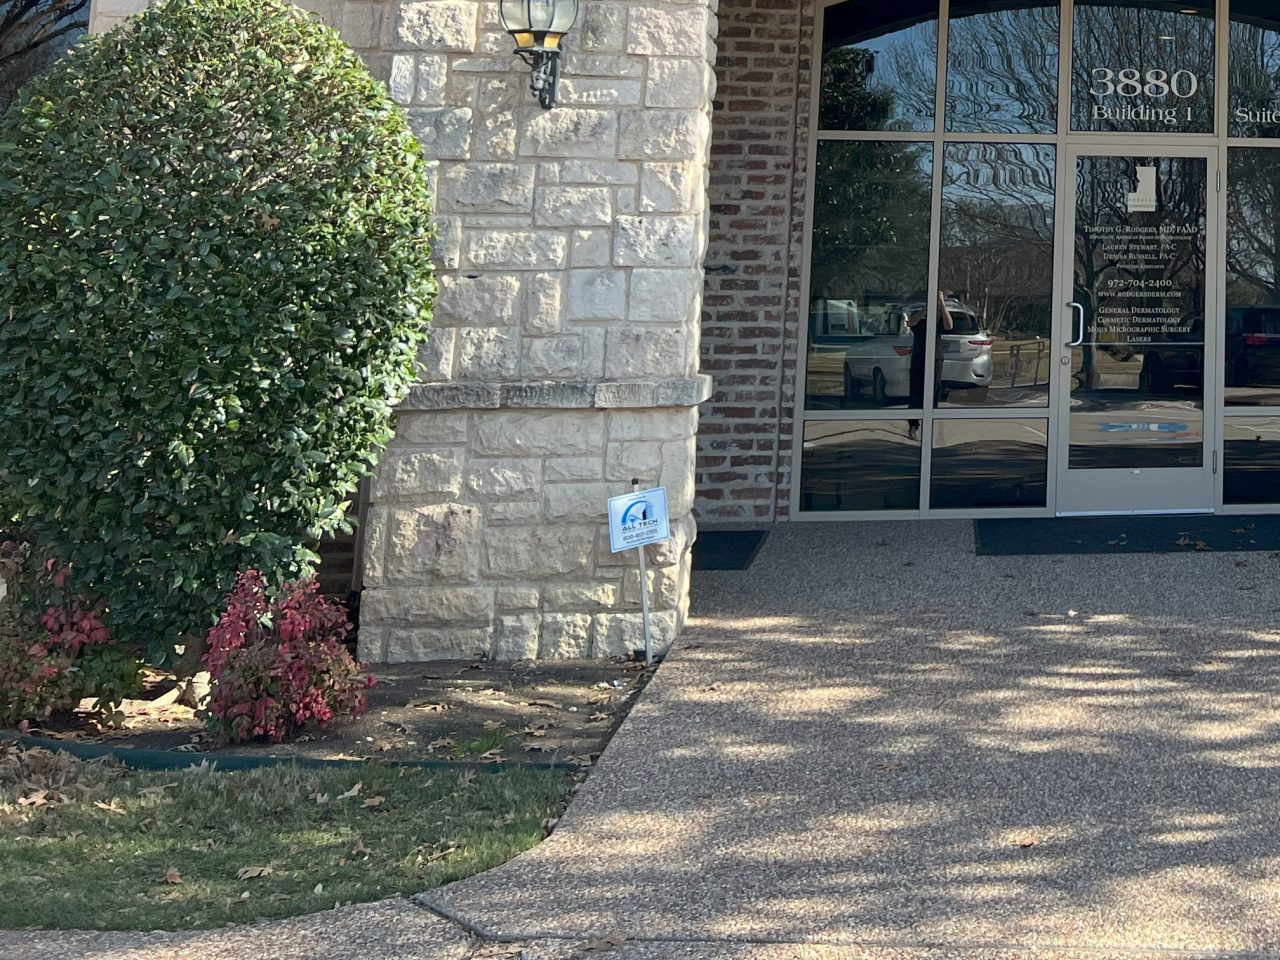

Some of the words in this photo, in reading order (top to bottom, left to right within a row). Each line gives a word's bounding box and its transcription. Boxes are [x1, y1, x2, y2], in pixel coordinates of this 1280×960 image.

[1089, 67, 1198, 98] 3880
[1092, 104, 1177, 125] Building
[1187, 107, 1192, 121] 1
[1084, 225, 1114, 233] TIMOTHY
[1176, 225, 1198, 233] FAAD
[1102, 243, 1127, 251] LAUREN
[1160, 243, 1177, 251] PA-C
[1159, 252, 1176, 260] PA-C
[1107, 279, 1172, 288] 972-704-2400
[1098, 306, 1130, 314] GENERAL
[1131, 306, 1180, 314] DERMATOLOGY
[1132, 316, 1181, 324] DERMATOLOGY
[1109, 325, 1160, 333] MICROGRAPHIC
[1161, 325, 1191, 333] SURGERY
[1126, 335, 1152, 343] LASERS
[638, 519, 658, 527] TECH
